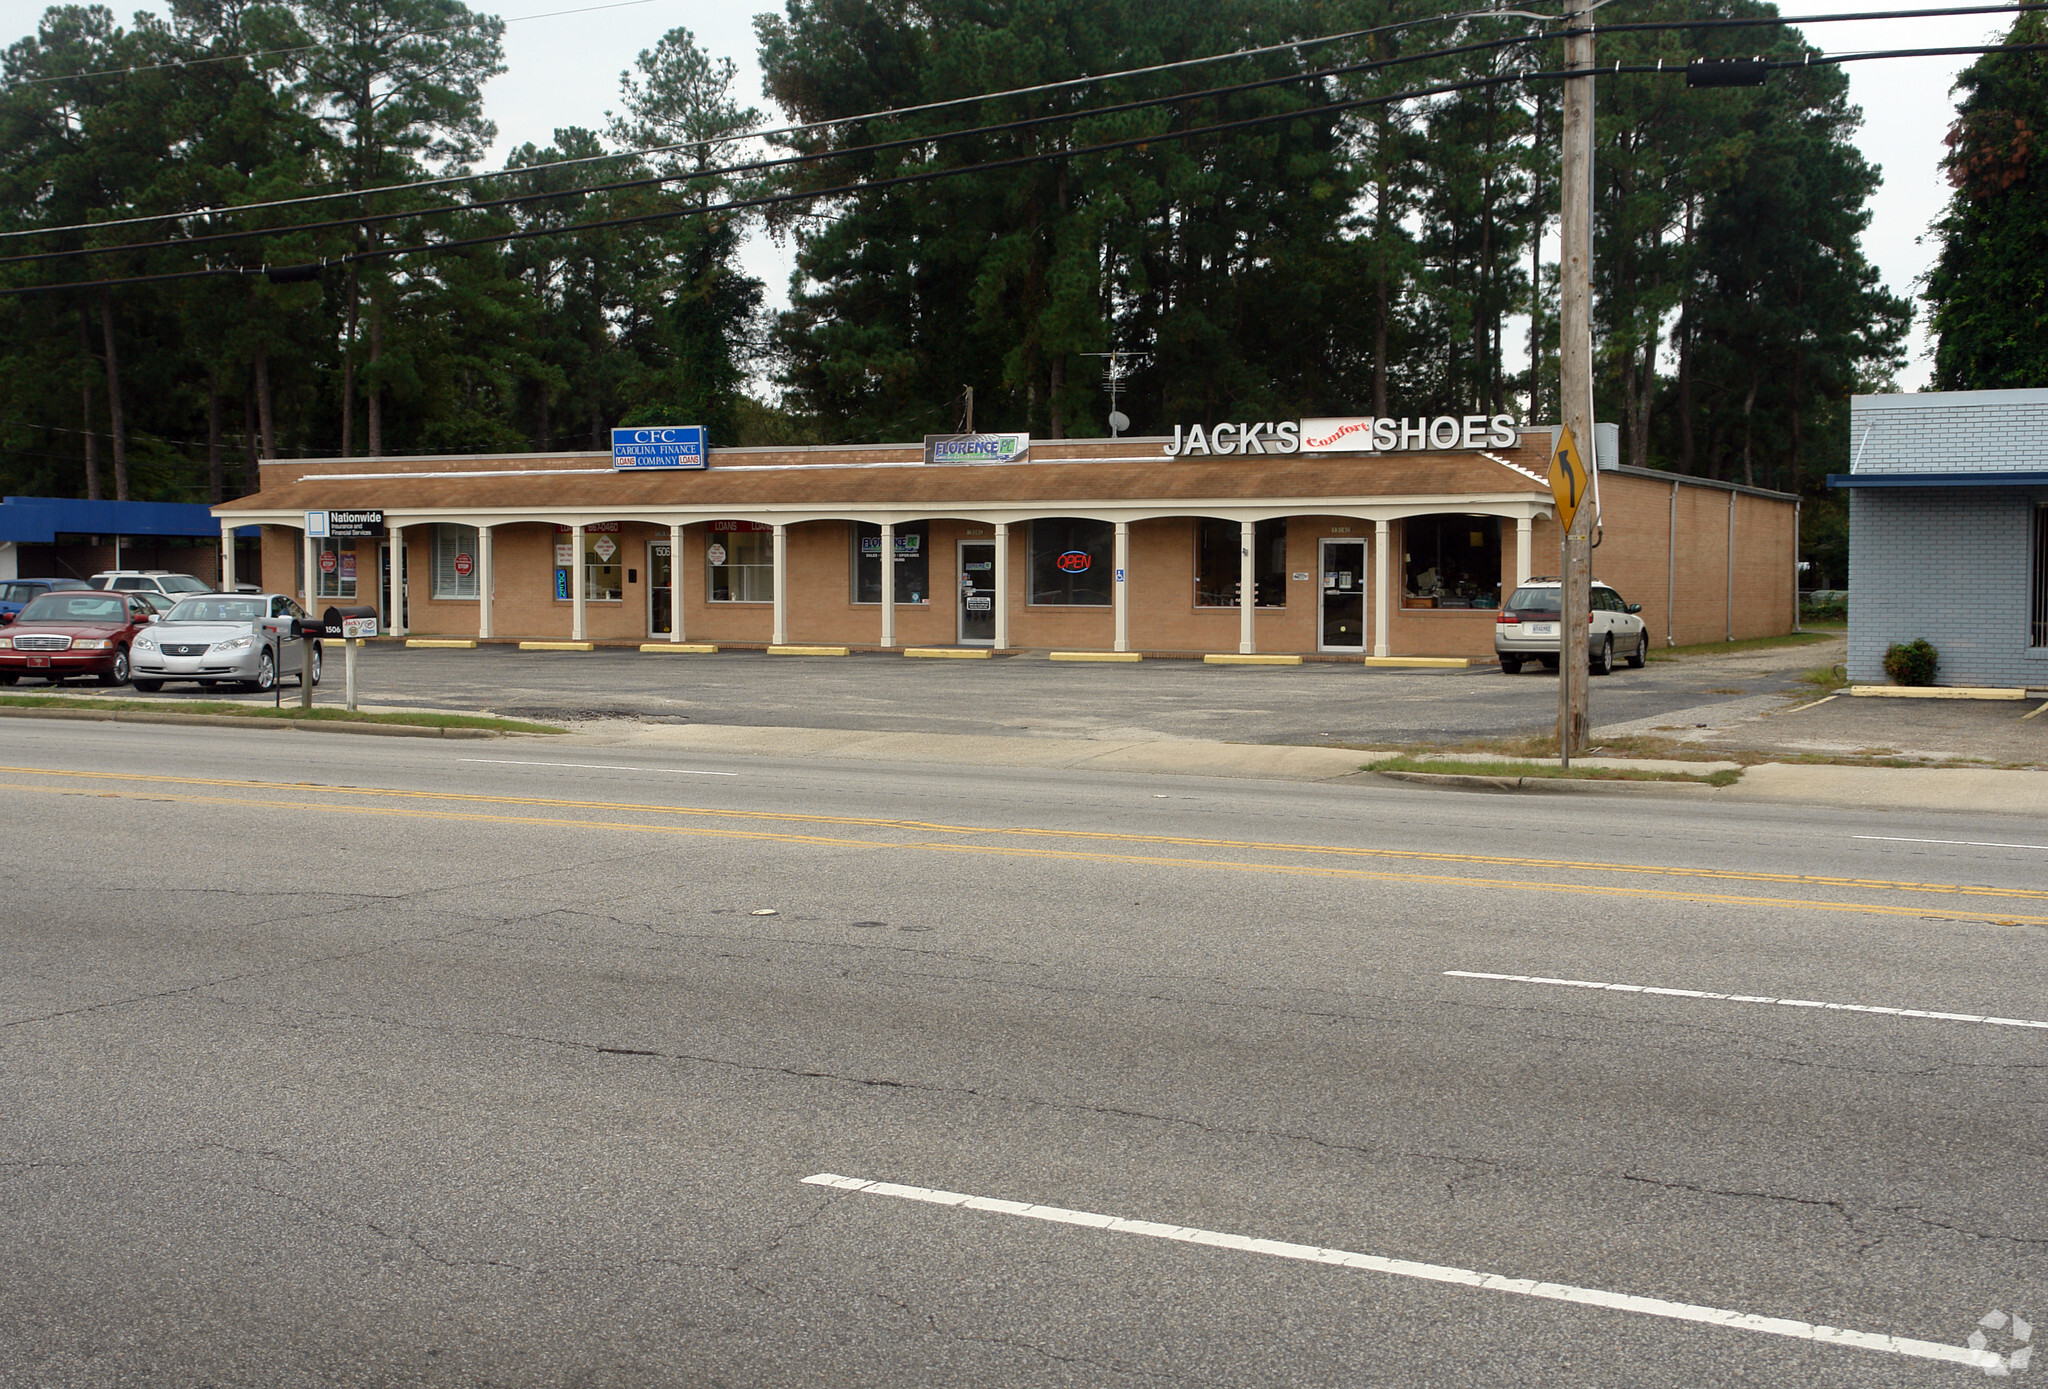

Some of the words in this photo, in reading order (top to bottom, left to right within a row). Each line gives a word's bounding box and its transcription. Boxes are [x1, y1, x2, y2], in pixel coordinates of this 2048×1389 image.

[634, 429, 676, 443] CFC
[1163, 422, 1299, 455] JACK'S
[1306, 422, 1370, 449] Comfort
[1373, 414, 1517, 451] SHOES
[615, 445, 656, 455] CAROLINA
[660, 444, 696, 454] FINANCE
[936, 441, 998, 455] FLORENCE
[1000, 439, 1014, 452] PC
[616, 457, 635, 465] LOANS
[637, 456, 677, 466] COMPANY
[679, 455, 699, 464] LOANS
[331, 512, 381, 523] Nationwide
[714, 521, 737, 531] LOANS
[1056, 554, 1092, 569] OPEN
[325, 625, 341, 634] 1506
